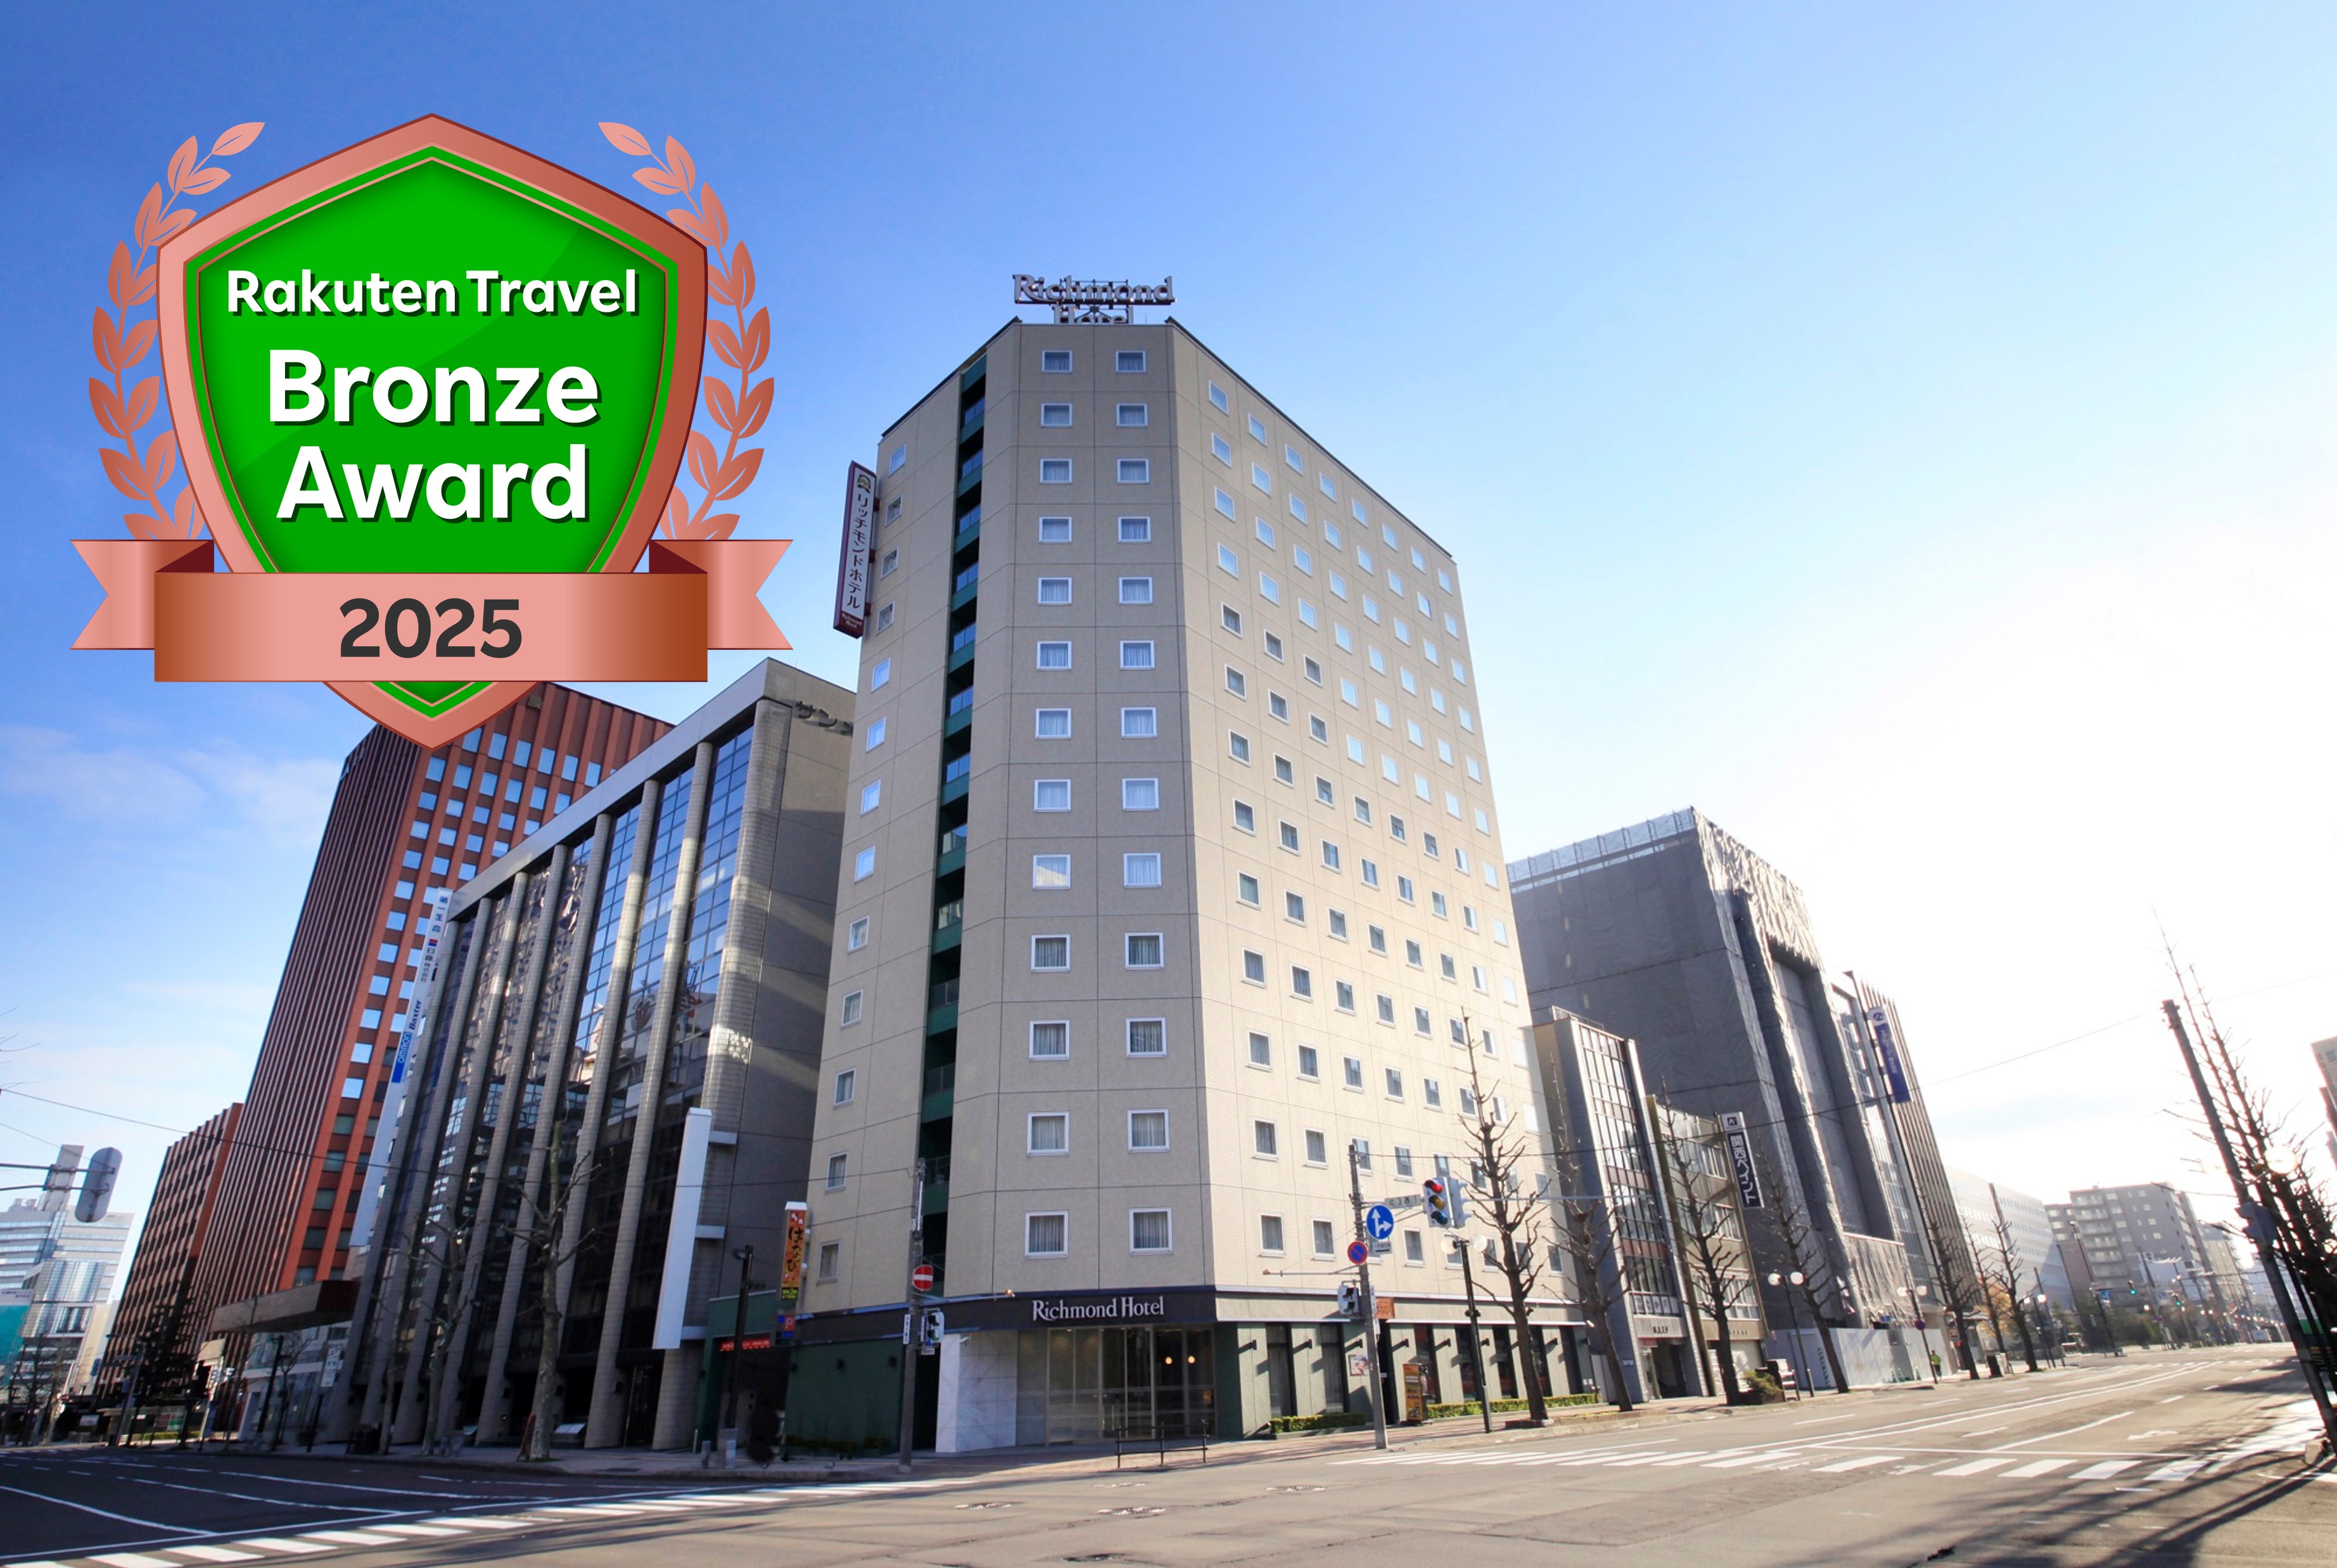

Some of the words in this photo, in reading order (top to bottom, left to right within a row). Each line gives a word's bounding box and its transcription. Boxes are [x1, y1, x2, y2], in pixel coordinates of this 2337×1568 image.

[1012, 274, 1176, 303] Richmond
[1052, 303, 1134, 324] Hotel
[846, 494, 869, 609] リッチモンドホテル
[409, 999, 422, 1030] Baxter
[1730, 1135, 1756, 1204] 関西ペイント
[1032, 1297, 1118, 1321] Richmond
[1121, 1296, 1164, 1318] Hotel
[786, 1317, 794, 1330] P
